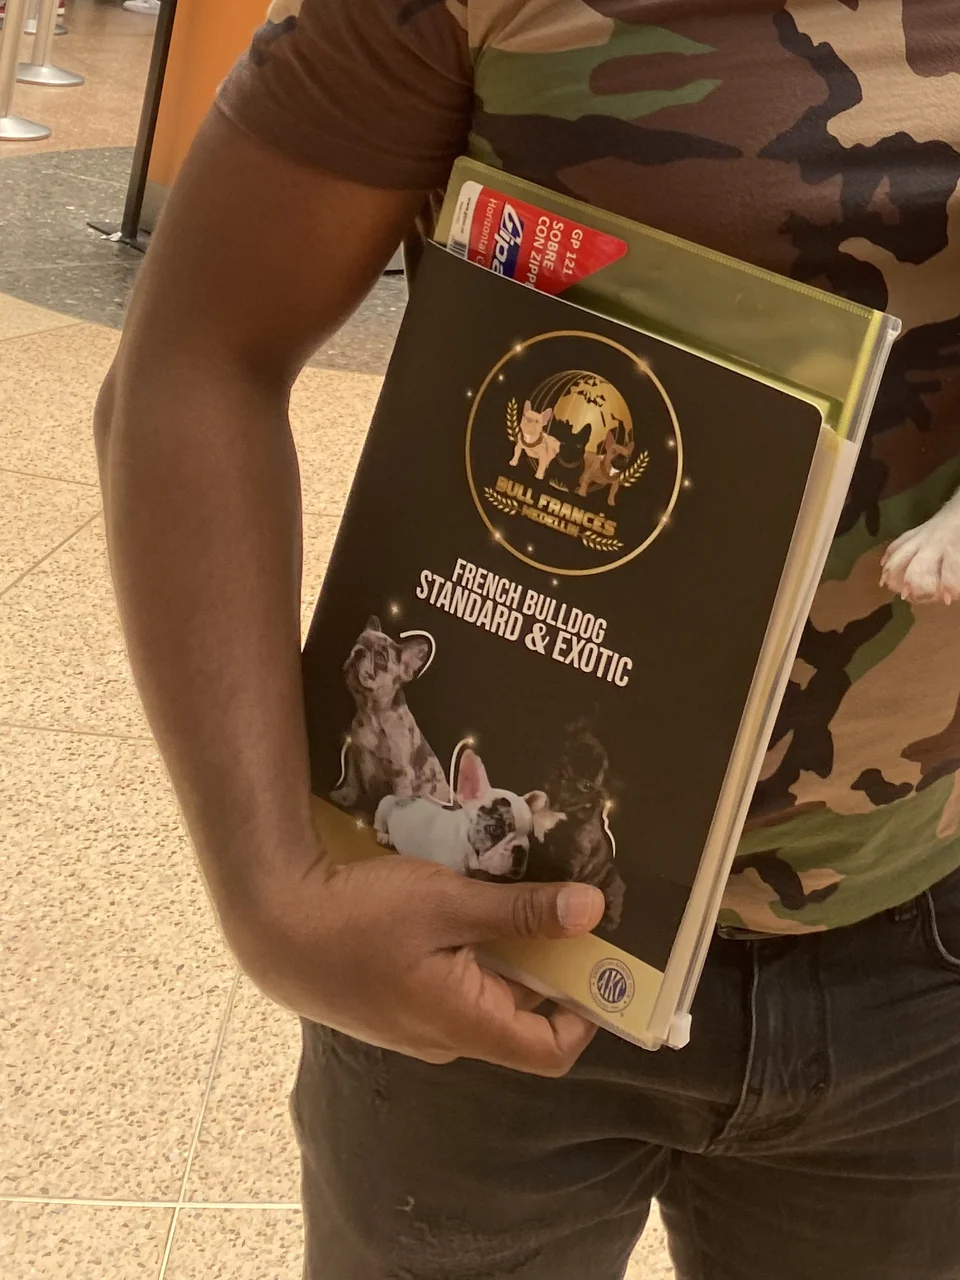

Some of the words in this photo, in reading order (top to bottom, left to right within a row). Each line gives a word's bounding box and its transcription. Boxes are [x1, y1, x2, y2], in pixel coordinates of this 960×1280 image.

[478, 197, 498, 255] Horizontal
[533, 215, 550, 249] CON
[542, 220, 565, 270] SOBRE
[567, 228, 583, 249] GP
[562, 251, 577, 275] 121
[494, 474, 535, 506] BULL
[537, 492, 618, 538] FRANCÉS
[450, 557, 523, 610] FRENCH
[521, 587, 608, 644] BULLDOG
[415, 569, 524, 642] STANDARD
[524, 621, 551, 656] &
[551, 630, 633, 688] EXOTIC
